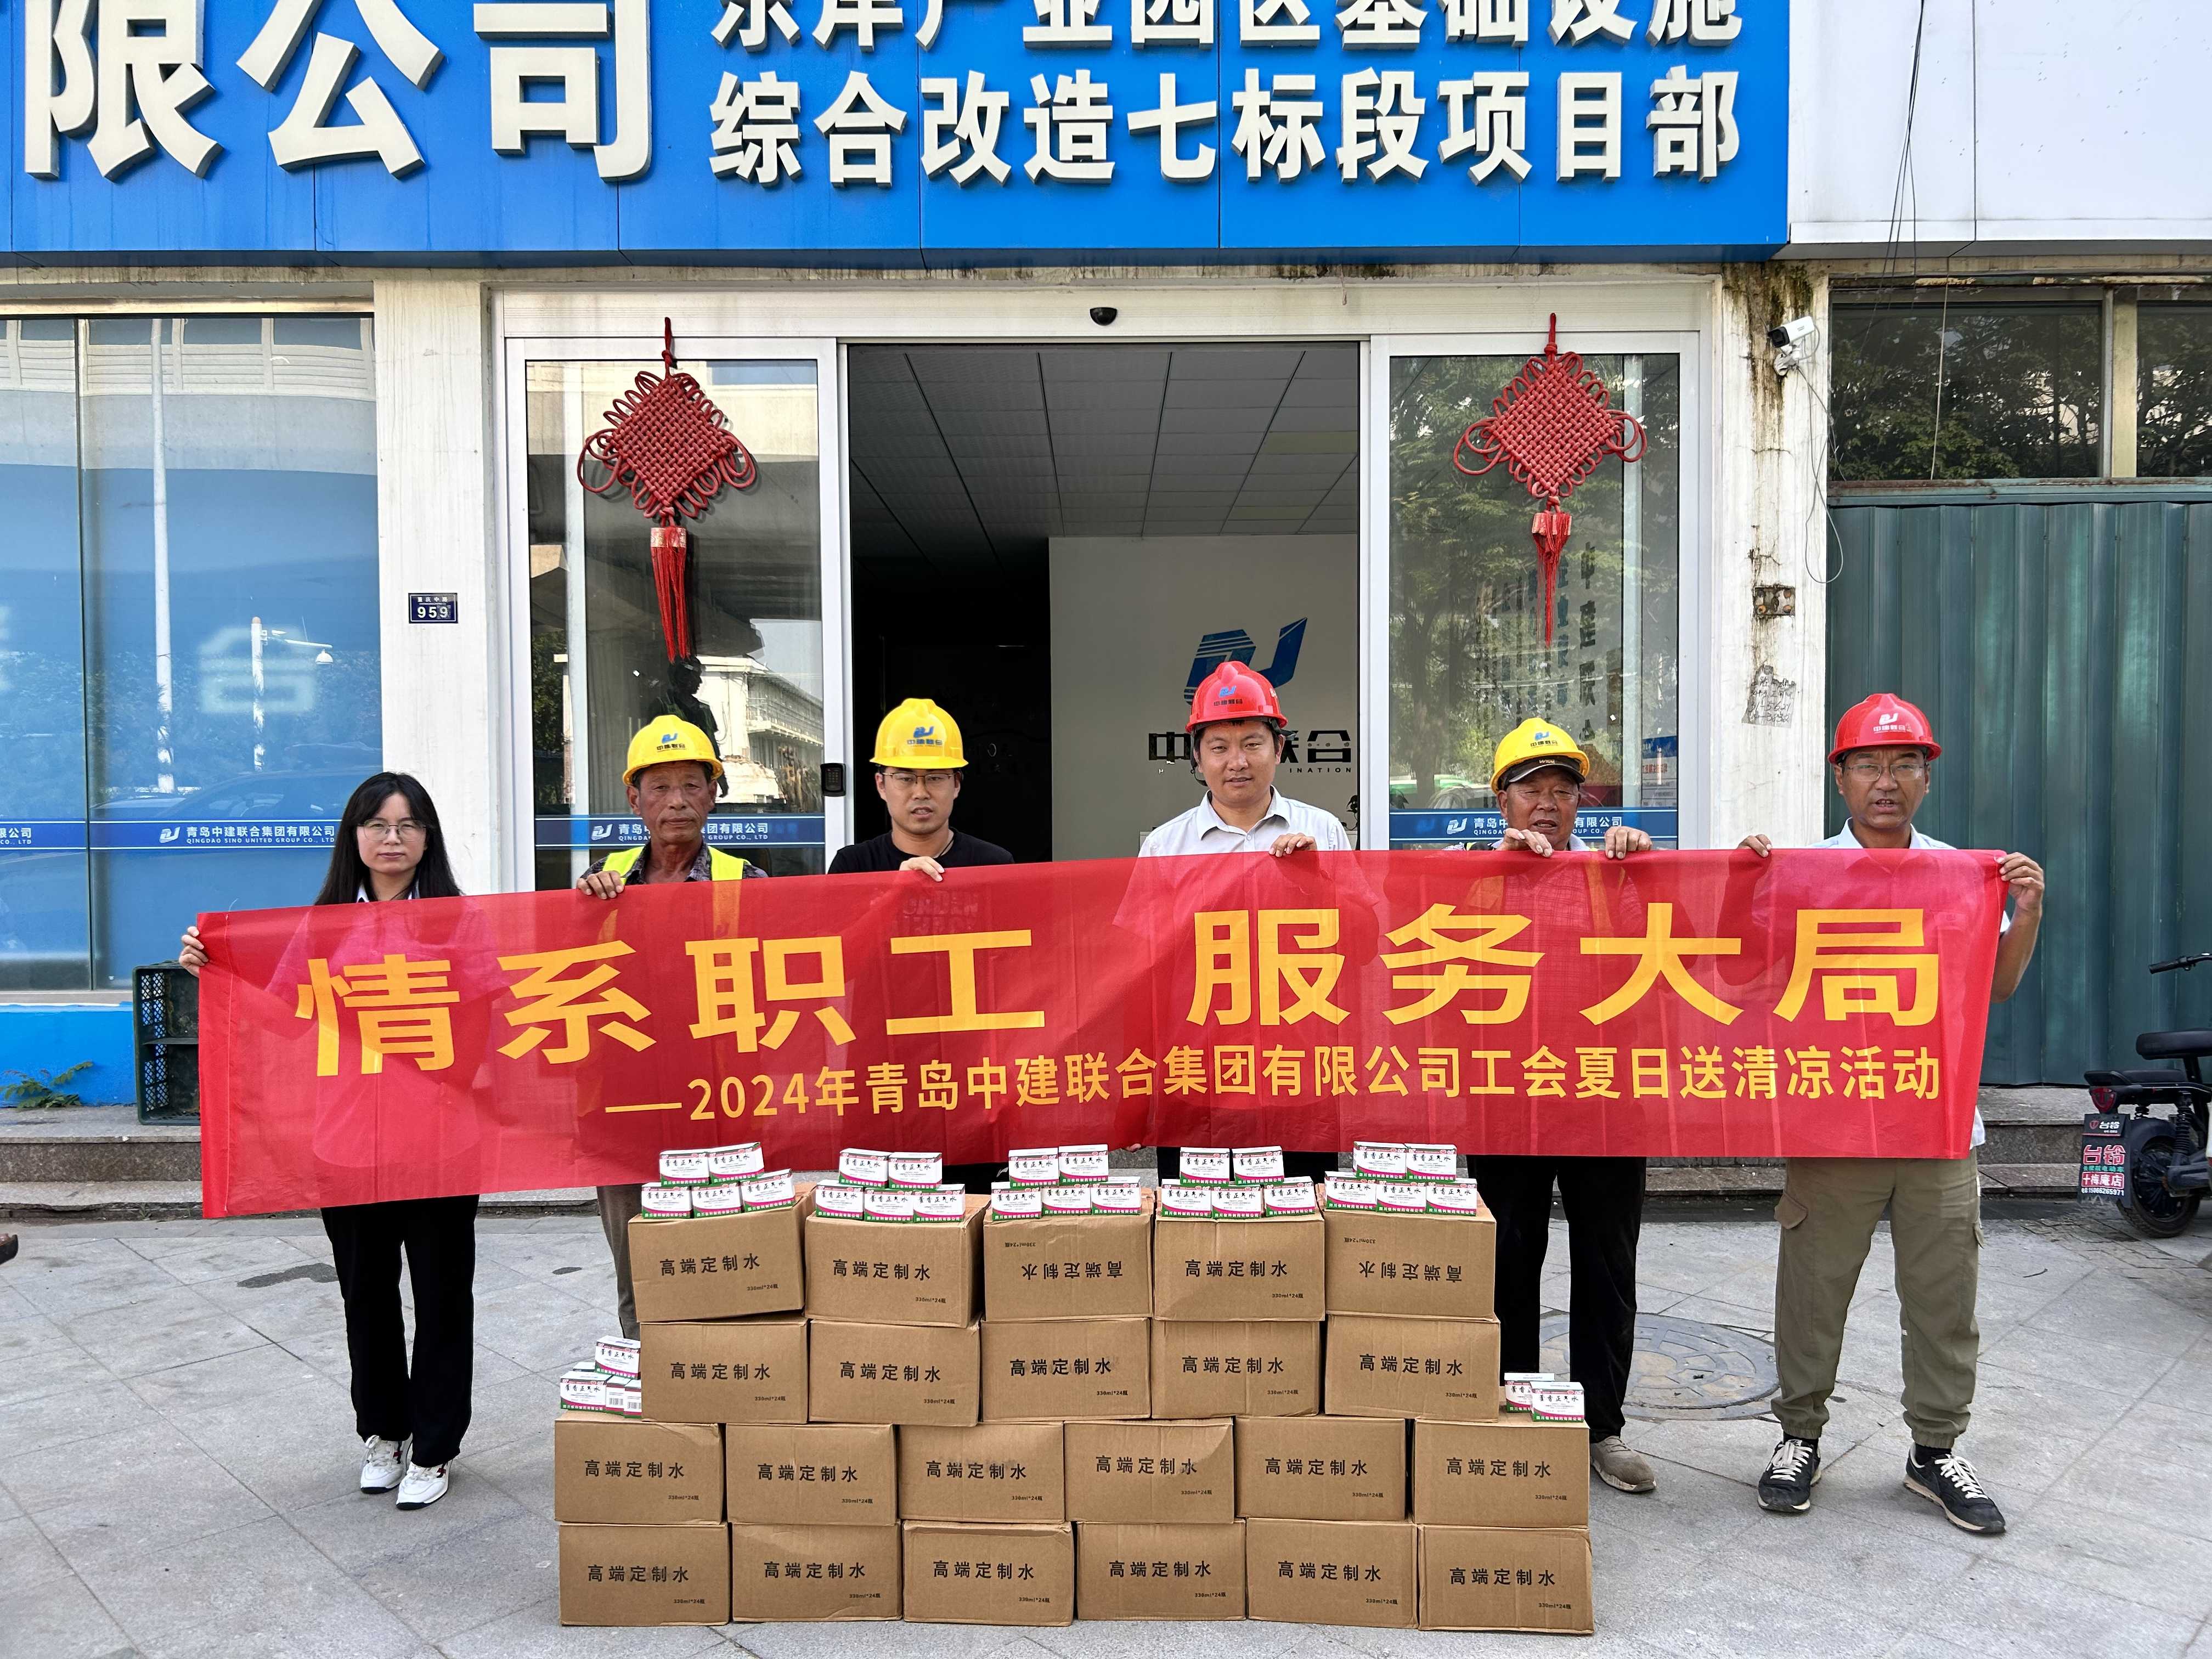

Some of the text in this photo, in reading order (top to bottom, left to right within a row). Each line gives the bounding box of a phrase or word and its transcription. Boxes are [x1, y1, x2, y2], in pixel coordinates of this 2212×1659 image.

[709, 65, 1740, 188] 综合改造七标段项目部
[417, 606, 448, 618] 959
[618, 823, 768, 836] 青岛团有限公司
[1474, 816, 1622, 829] 青岛中有限公司
[187, 826, 335, 838] 青岛中建联合集团有限公司
[297, 903, 1941, 1077] 情系职工 服务大局
[2083, 1144, 2126, 1165] 台铃
[2083, 1173, 2123, 1187] 十梅庵店
[660, 1254, 760, 1276] 高端定制水
[833, 1259, 930, 1280] 高端定制水
[1022, 1261, 1122, 1280] 高端定制水
[1186, 1260, 1287, 1277] 高端定制水
[1359, 1261, 1462, 1283] 高端定制水
[671, 1362, 770, 1380] 高端定制水
[840, 1361, 940, 1383] 高端定制水
[1010, 1358, 1111, 1376] 高端定制水
[1182, 1356, 1283, 1374] 高端定制水
[1360, 1354, 1462, 1376] 高端定制水
[585, 1460, 684, 1479] 高端定制水
[758, 1464, 857, 1482] 高端定制水
[927, 1461, 1026, 1480] 高端定制水
[1096, 1455, 1197, 1475] 高端定制水
[1266, 1458, 1367, 1476] 高端定制水
[1447, 1458, 1550, 1477] 高端定制水
[588, 1565, 689, 1582] 高端定制水
[764, 1561, 865, 1578] 高端定制水
[934, 1560, 1034, 1580] 高端定制水
[1109, 1561, 1211, 1577] 高端定制水
[1278, 1561, 1381, 1582] 高端定制水
[1450, 1568, 1555, 1586] 高端定制水
